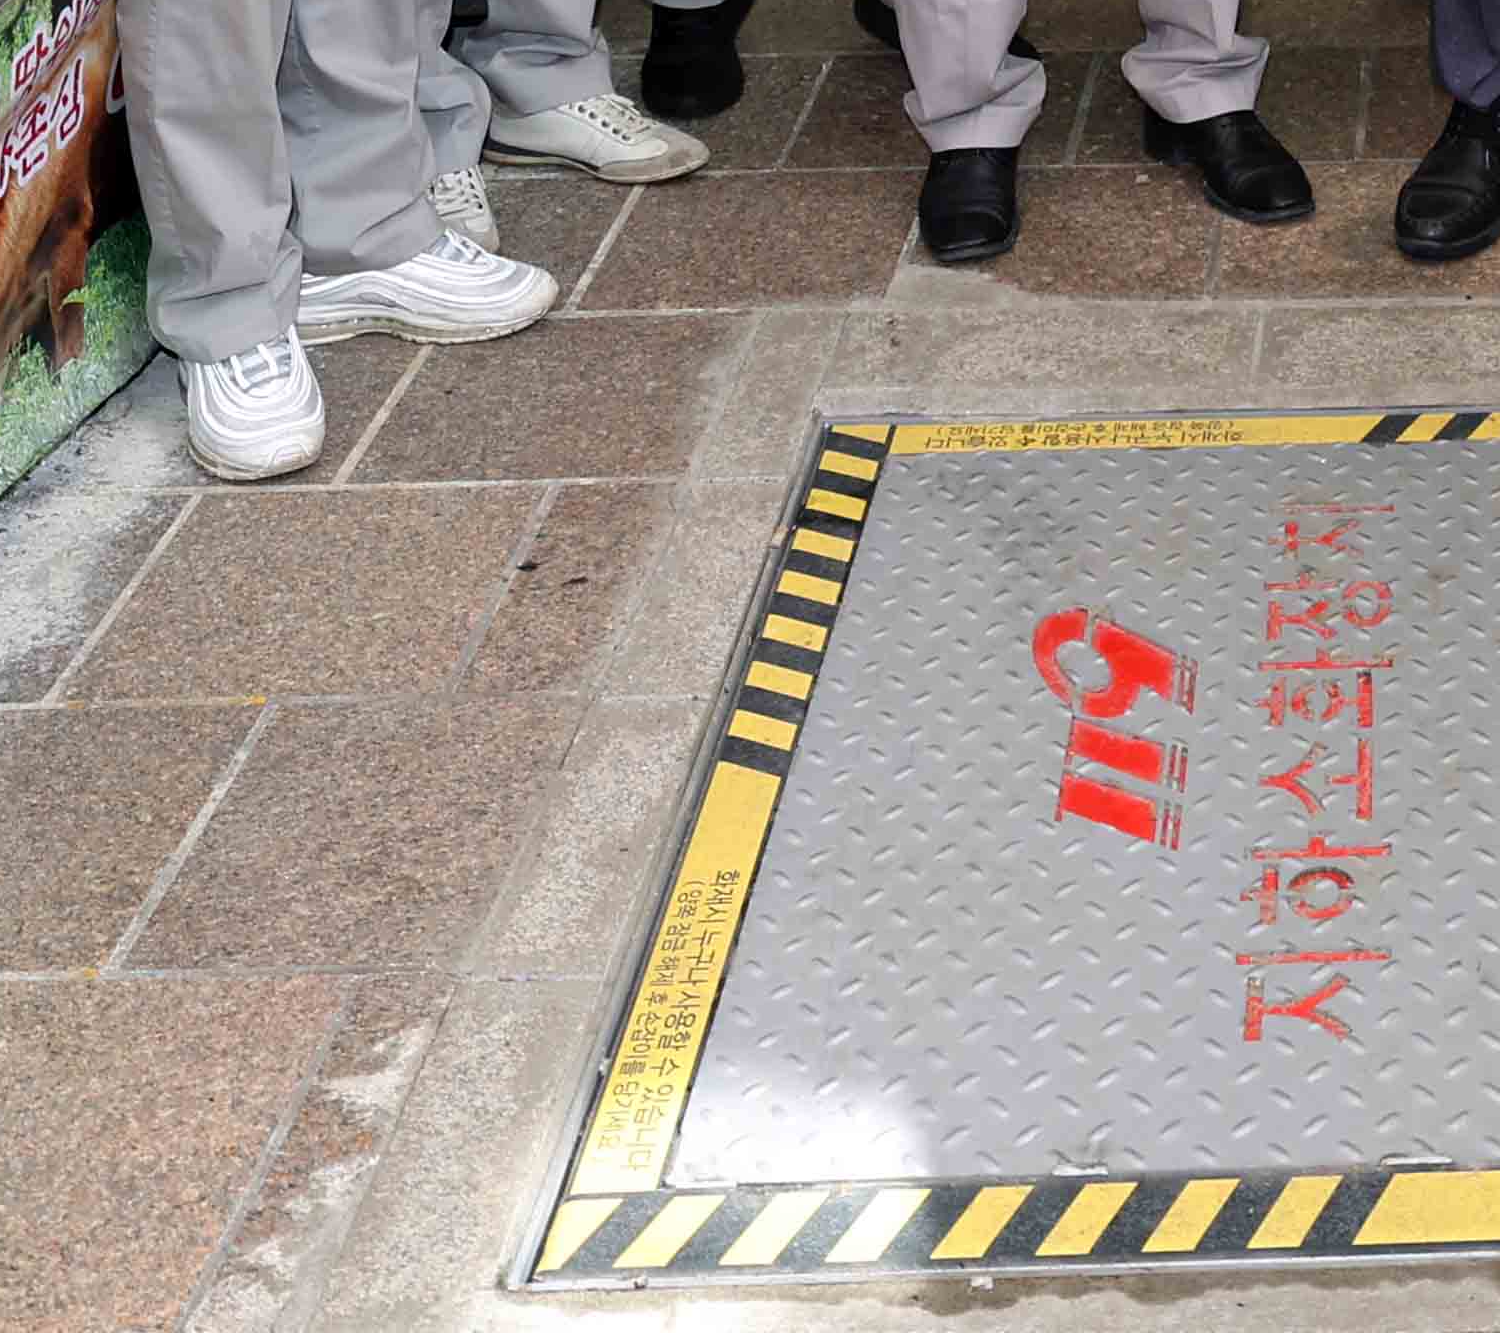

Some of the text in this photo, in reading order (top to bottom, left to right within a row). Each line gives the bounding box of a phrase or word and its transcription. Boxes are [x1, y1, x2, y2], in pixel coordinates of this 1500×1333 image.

[1032, 604, 1200, 852] 119
[1235, 503, 1396, 1042] 지하소화장치
[699, 868, 741, 924] 화재시
[678, 928, 723, 986] 누구나
[658, 990, 702, 1051] 사용할
[649, 1056, 681, 1078] 수
